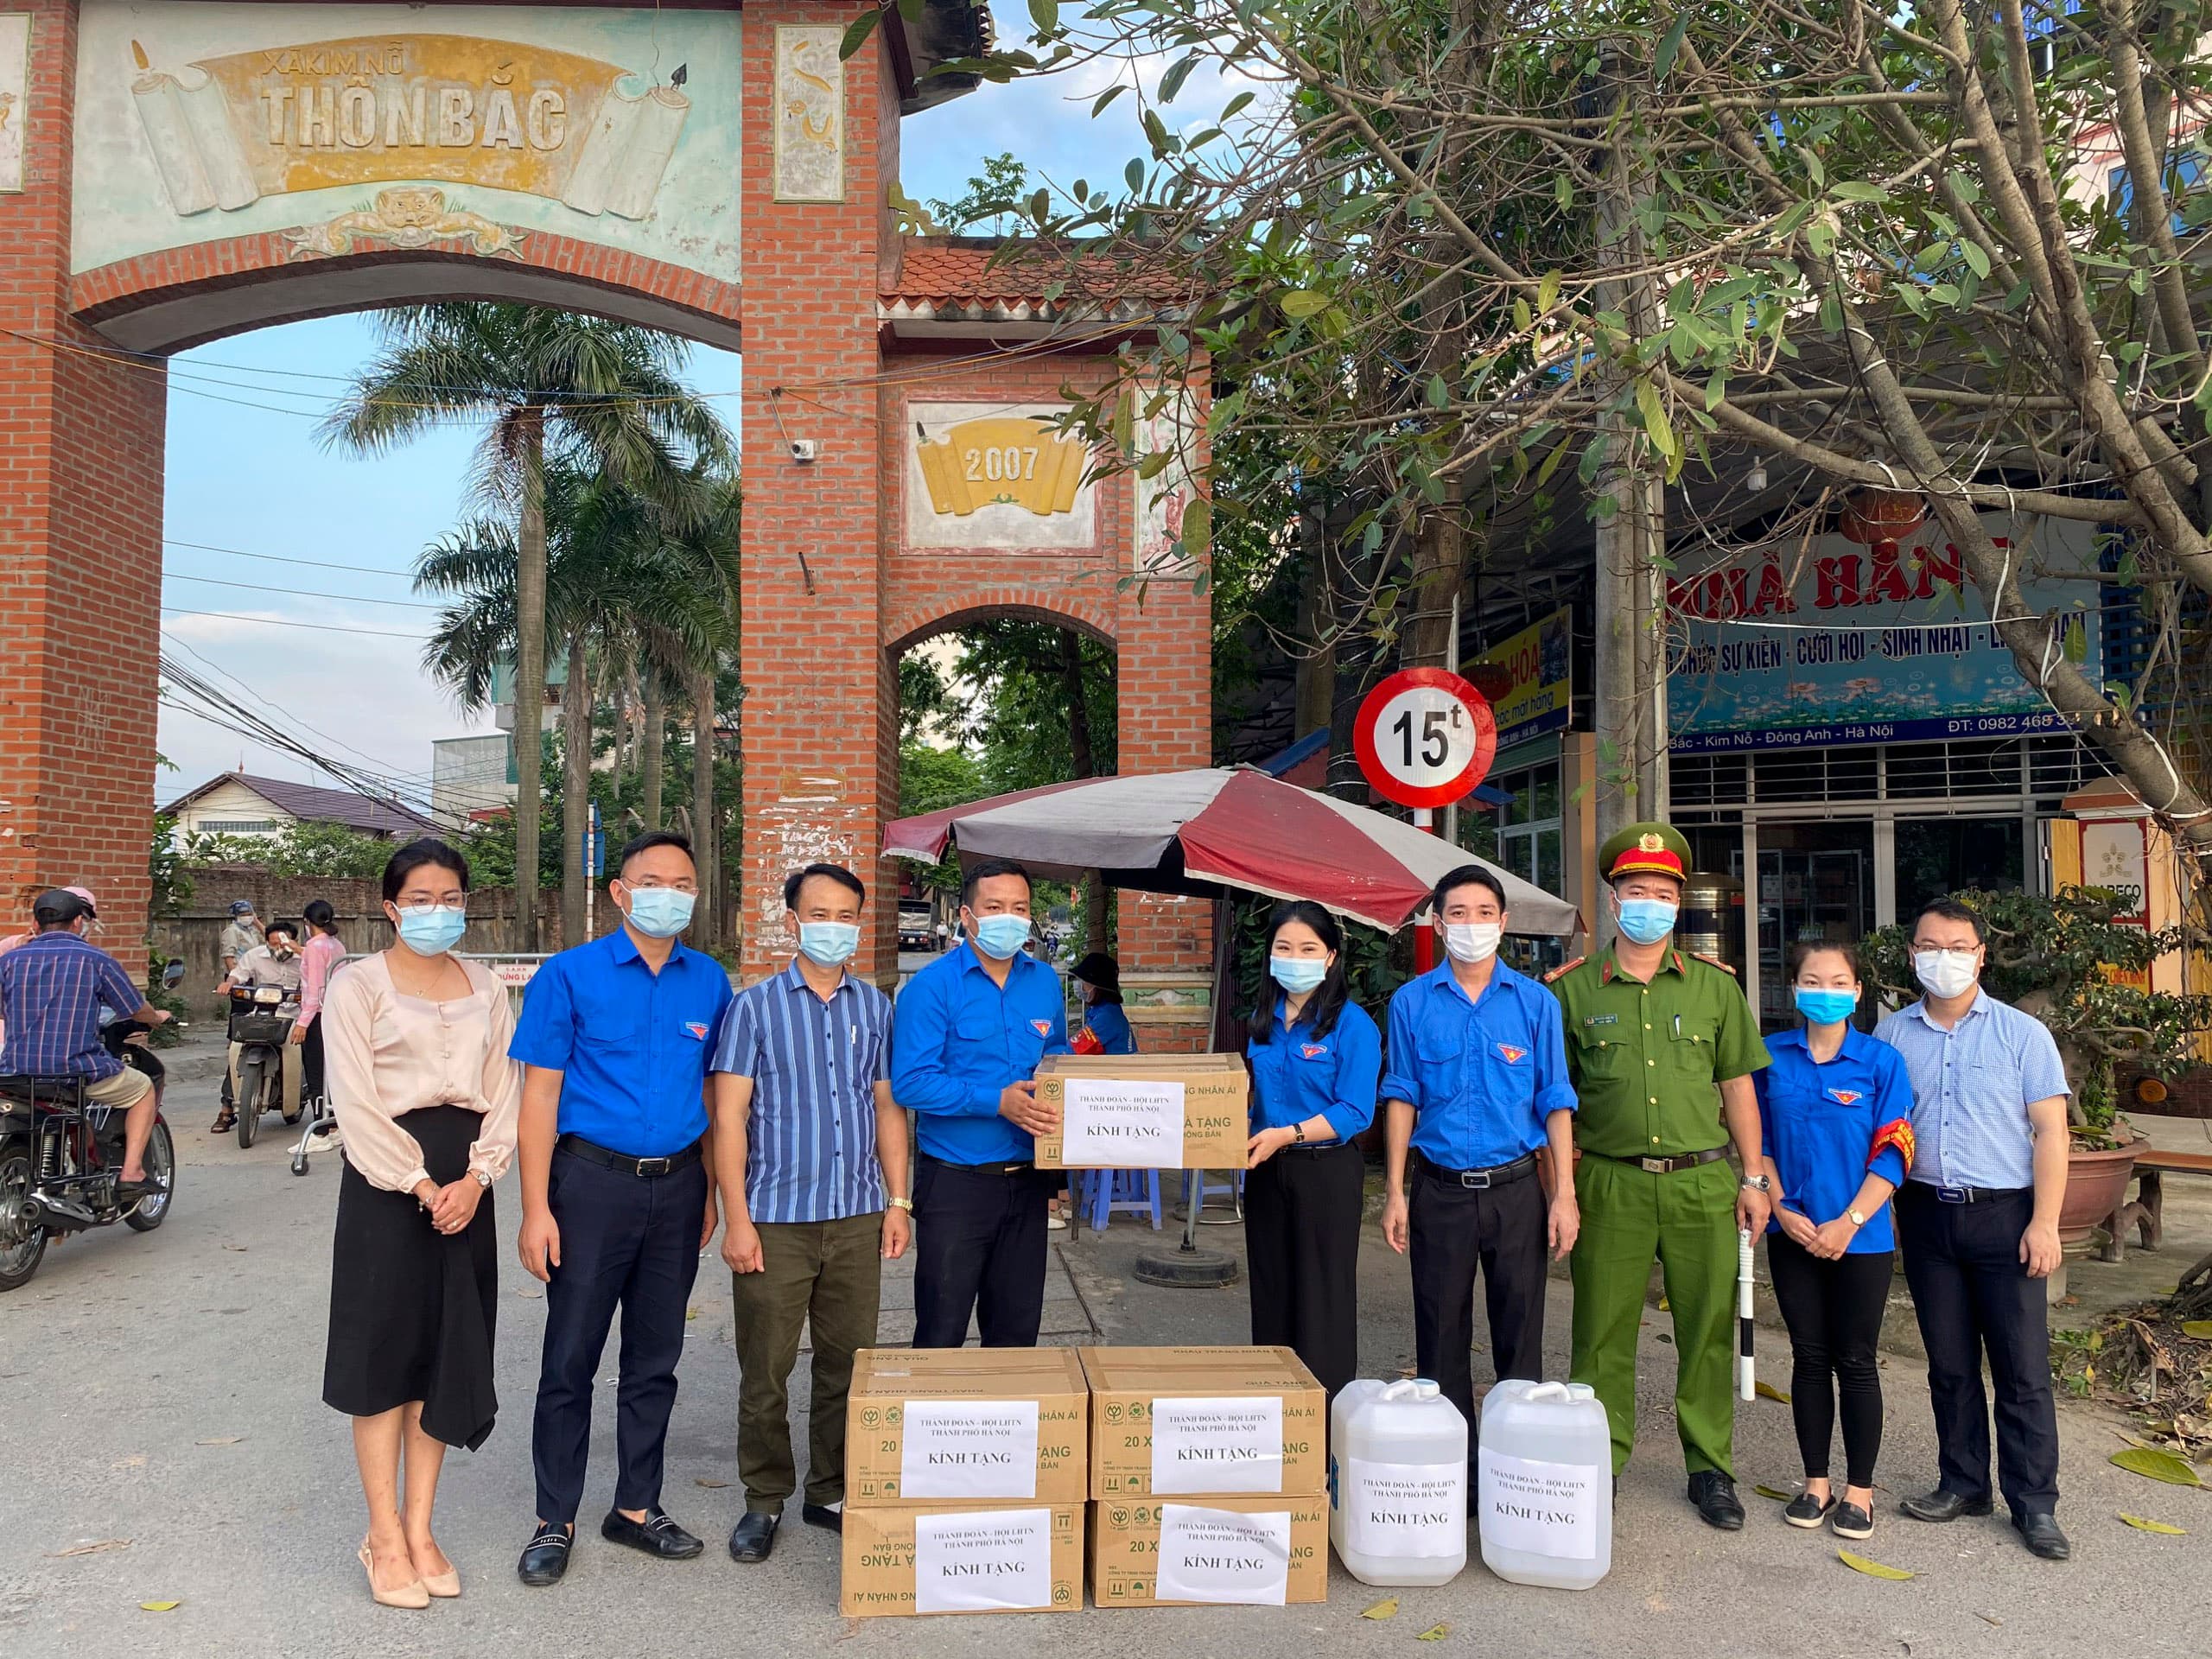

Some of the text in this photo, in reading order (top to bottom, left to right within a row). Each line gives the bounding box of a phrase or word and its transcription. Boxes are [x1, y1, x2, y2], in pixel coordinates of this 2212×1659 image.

[964, 447, 1040, 482] 2007
[1746, 634, 1781, 674] KIỆN
[1797, 629, 1834, 665] CƯỚI
[1882, 629, 1922, 658] SINH
[1928, 616, 1971, 659] NHẬT
[1948, 719, 1974, 733] ĐT:
[1979, 717, 2018, 730] 0982
[2022, 715, 2053, 728] 468
[1669, 737, 1694, 750] Bắc
[1706, 735, 1730, 747] Kim
[1734, 731, 1753, 746] Nỗ
[1765, 731, 1801, 745] Đông
[1805, 728, 1832, 741] Anh
[1846, 727, 1865, 739] Hà
[1870, 725, 1894, 740] Nội
[1087, 1123, 1160, 1139] KÍNH TẶNG
[881, 1440, 897, 1452] 20
[1124, 1436, 1153, 1447] 20 X
[928, 1450, 1011, 1466] KÍNH TẶNG
[1178, 1446, 1258, 1462] KÍNH TẶNG
[1370, 1510, 1448, 1527] KÍNH TẶNG
[1496, 1502, 1575, 1525] KÍNH TẶNG
[1129, 1541, 1158, 1553] 20 X
[943, 1561, 1025, 1577] KÍNH TẶNG
[1184, 1554, 1264, 1572] KÍNH TẶNG
